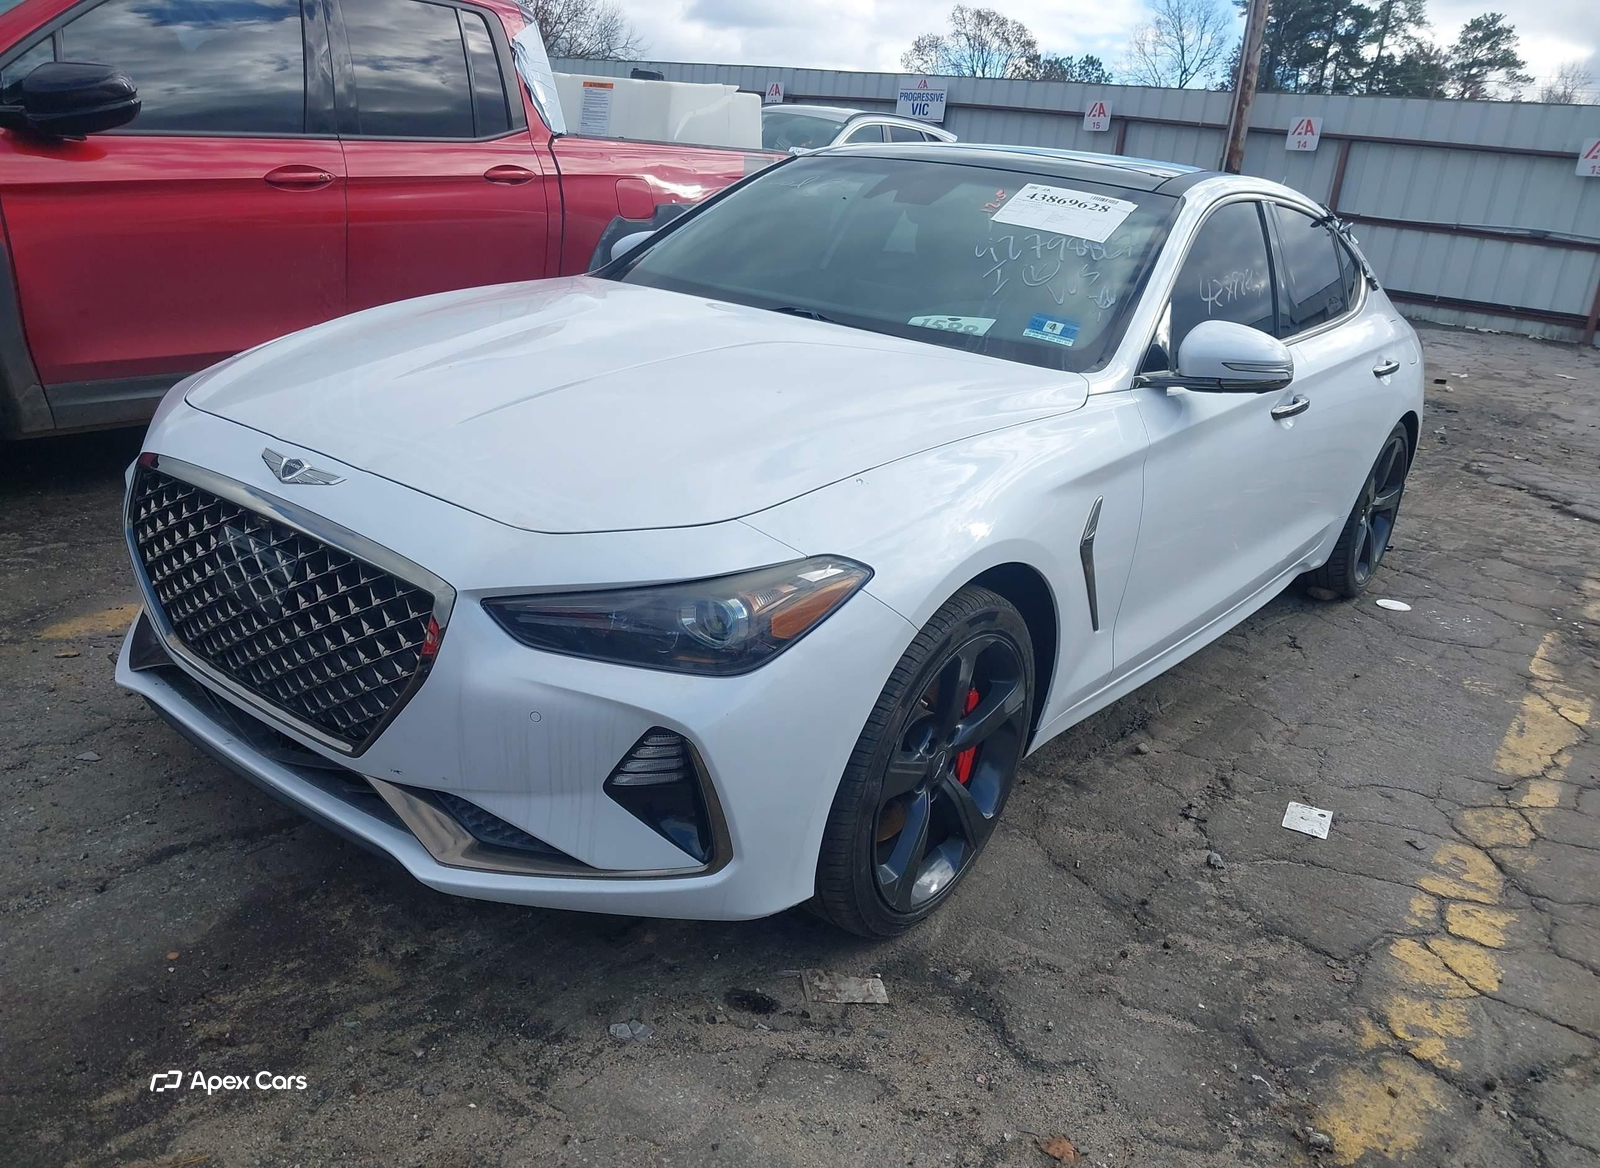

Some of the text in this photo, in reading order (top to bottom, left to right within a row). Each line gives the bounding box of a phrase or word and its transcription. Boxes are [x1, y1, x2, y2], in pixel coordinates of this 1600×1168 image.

[899, 92, 945, 103] PROGRESSIVE
[911, 103, 930, 116] VIC
[1092, 121, 1101, 130] 15
[1296, 140, 1308, 149] 14
[1027, 192, 1111, 212] 43869628
[1049, 323, 1058, 333] 4
